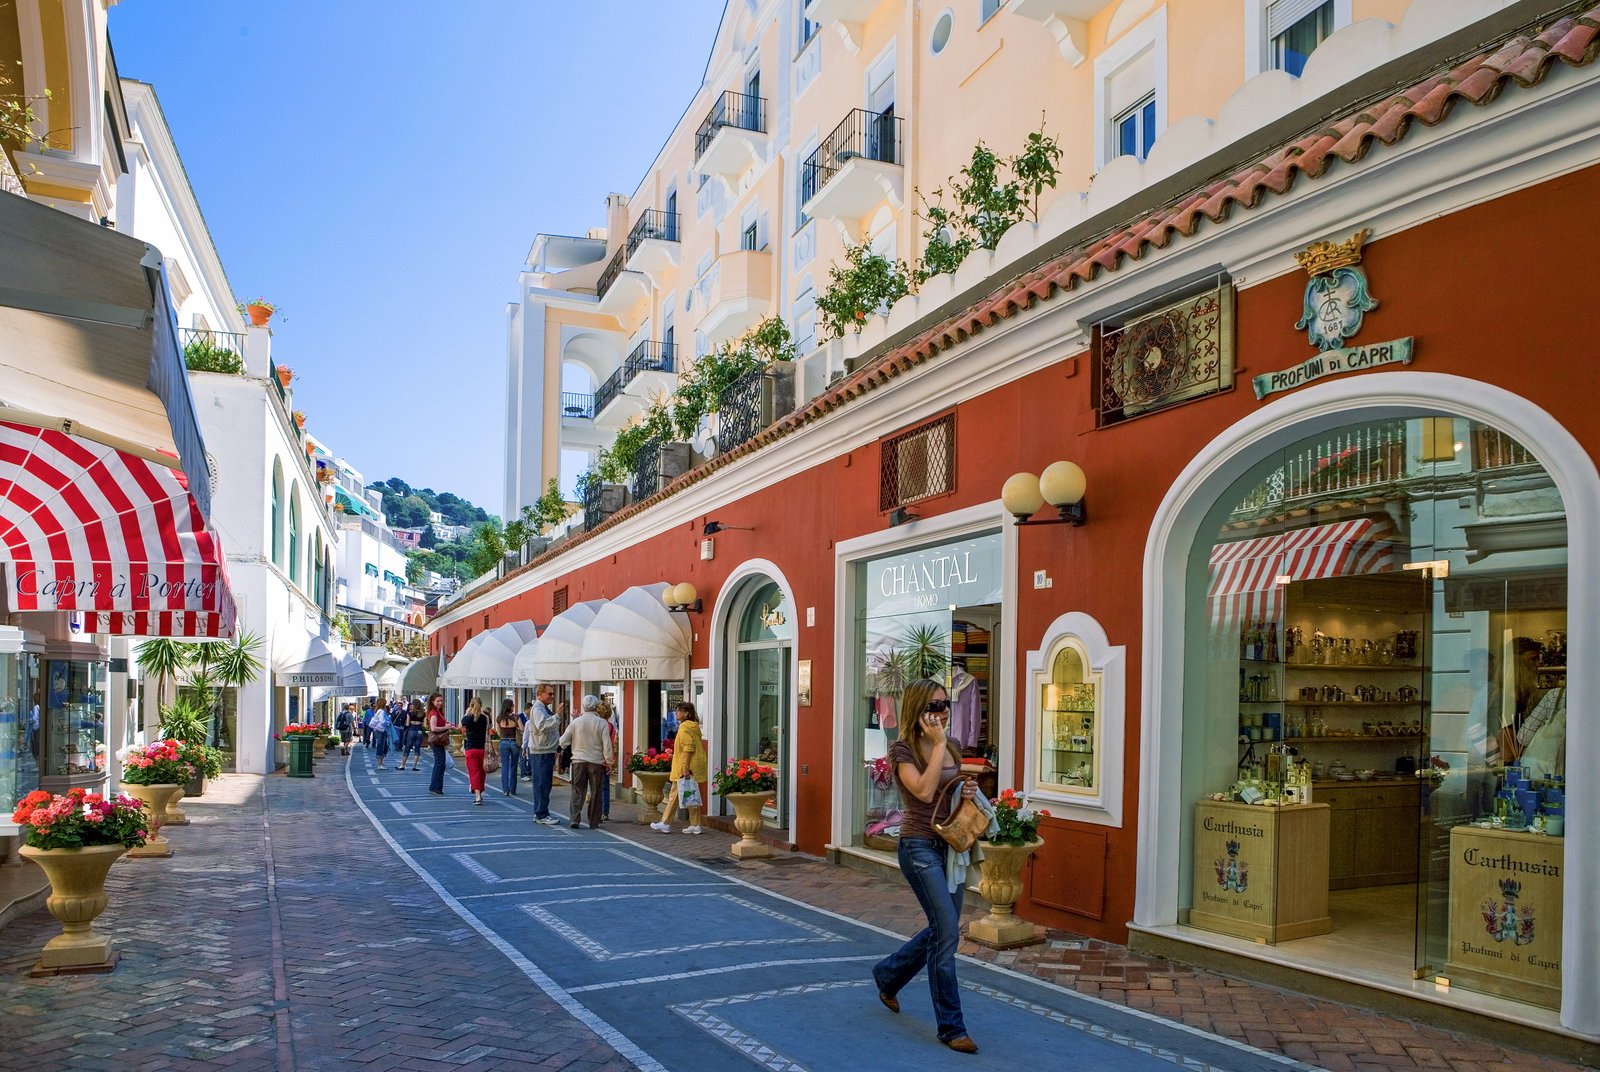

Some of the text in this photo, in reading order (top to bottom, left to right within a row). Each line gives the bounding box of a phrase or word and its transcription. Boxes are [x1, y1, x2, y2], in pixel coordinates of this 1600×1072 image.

[1271, 358, 1324, 389] PROFUMI
[1347, 345, 1393, 368] CAPRI
[16, 569, 216, 605] Capri à Porter
[880, 551, 978, 597] CHANTAL
[913, 593, 939, 608] UOMO
[610, 658, 648, 667] GIANFRANCO
[1203, 816, 1264, 838] Carthusia
[1463, 847, 1560, 877] Carthusia
[1232, 898, 1239, 906] di
[1243, 899, 1264, 913] Capri
[1461, 940, 1560, 970] Profumi di Capri
